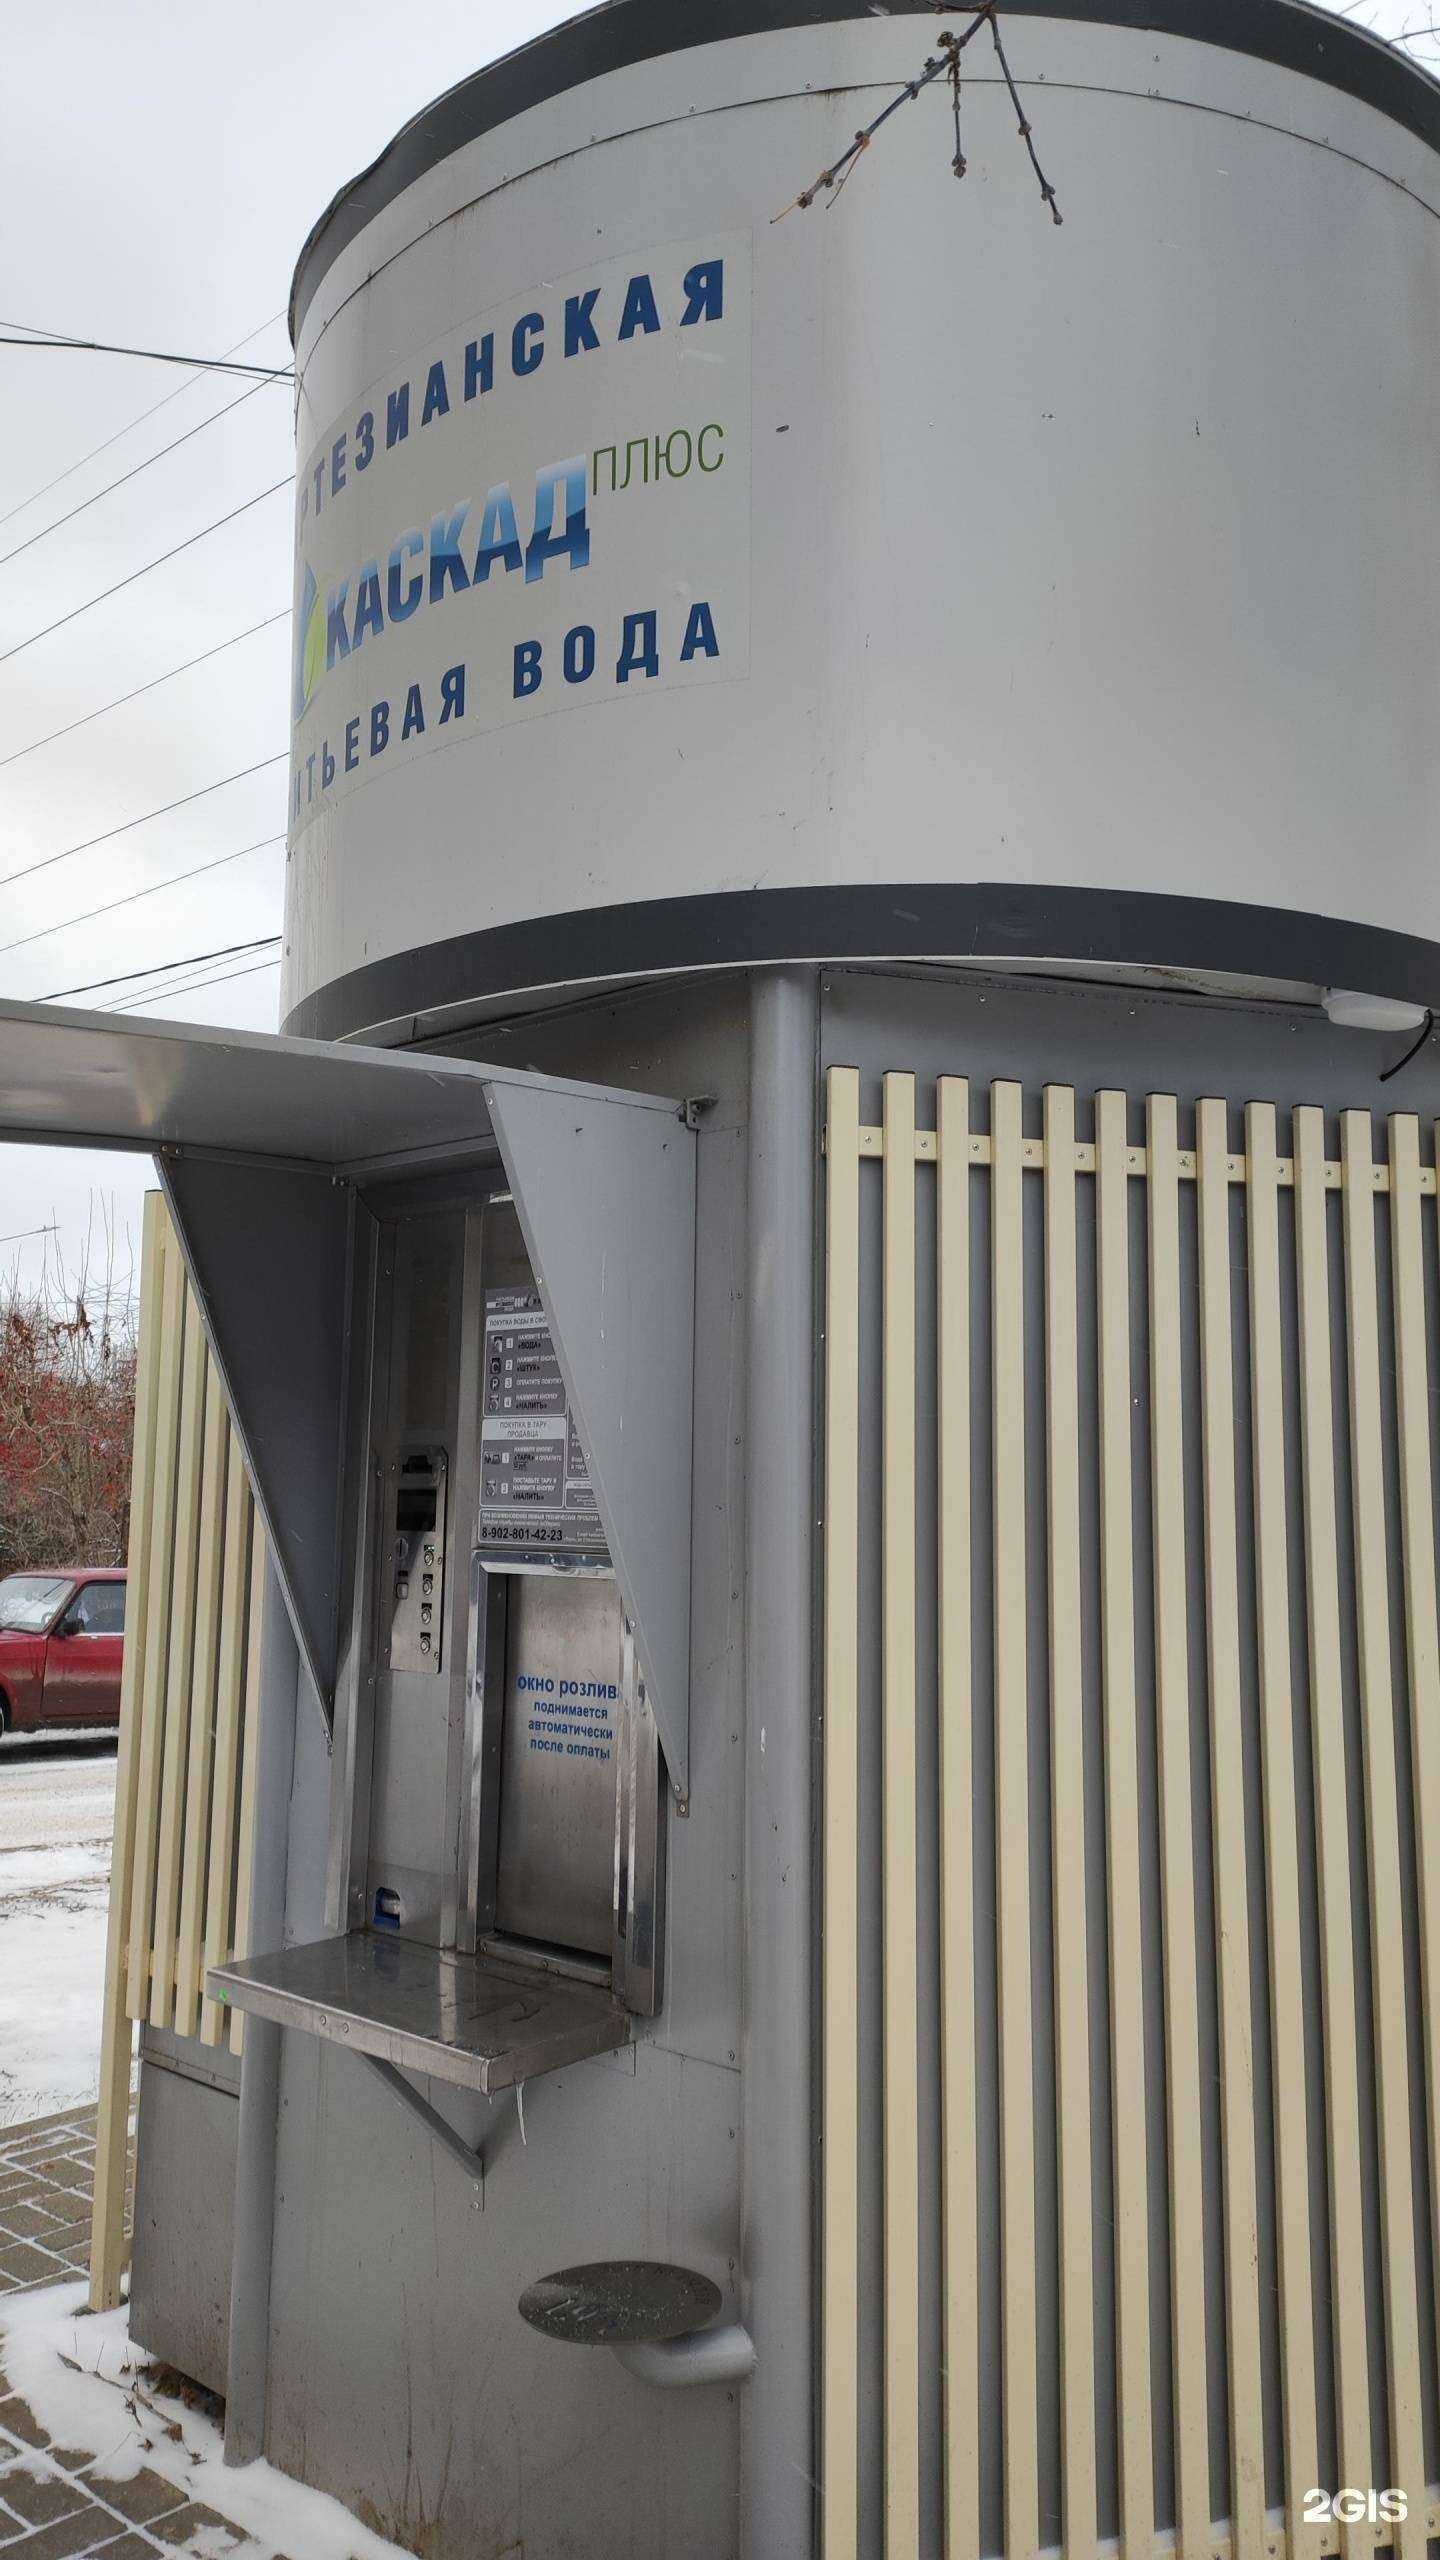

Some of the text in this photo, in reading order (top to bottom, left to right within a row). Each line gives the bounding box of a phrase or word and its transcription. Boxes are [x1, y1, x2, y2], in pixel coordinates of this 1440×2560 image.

[300, 259, 724, 530] РТЕЗИАНСКАЯ
[326, 423, 724, 671] КАСКАД ПЛЮС
[292, 601, 720, 821] ИТЬЕВАЯ ВОДА
[507, 1430, 539, 1438] ПРОДАВЦА
[481, 1526, 563, 1541] 8-902-801-42-23
[534, 1701, 608, 1719] поднимается
[528, 1719, 613, 1740] автоматически
[530, 1738, 610, 1760] после оплаты
